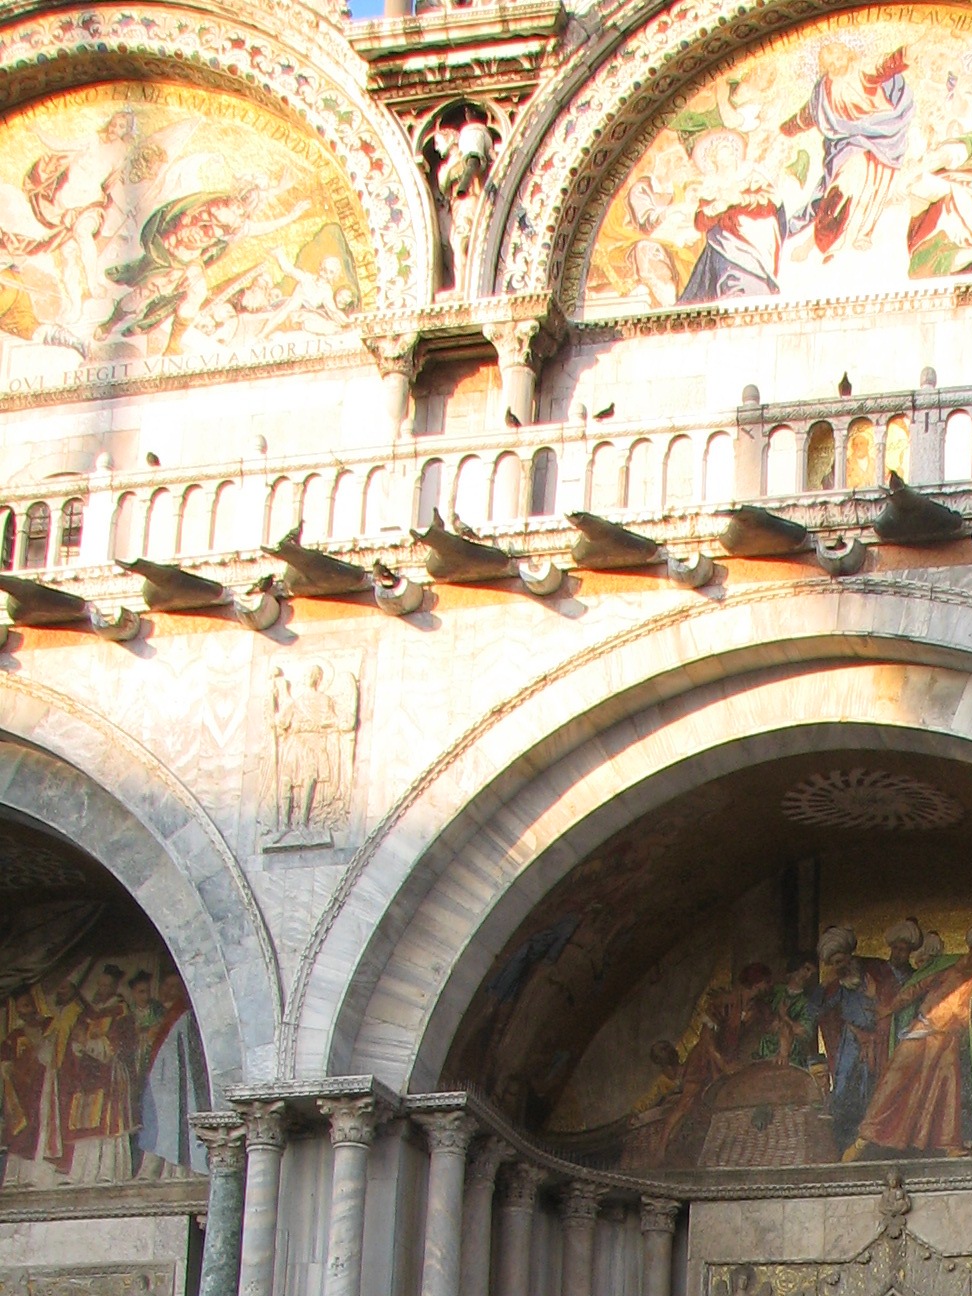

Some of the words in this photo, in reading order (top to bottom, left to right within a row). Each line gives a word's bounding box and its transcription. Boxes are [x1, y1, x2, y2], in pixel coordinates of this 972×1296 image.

[110, 86, 129, 100] ET
[568, 211, 599, 271] VICTOR
[591, 142, 640, 208] MORTIS
[634, 91, 689, 148] REGNO
[63, 363, 133, 386] FREGIT
[144, 352, 240, 375] VINCVLA
[250, 339, 333, 361] MORTIS
